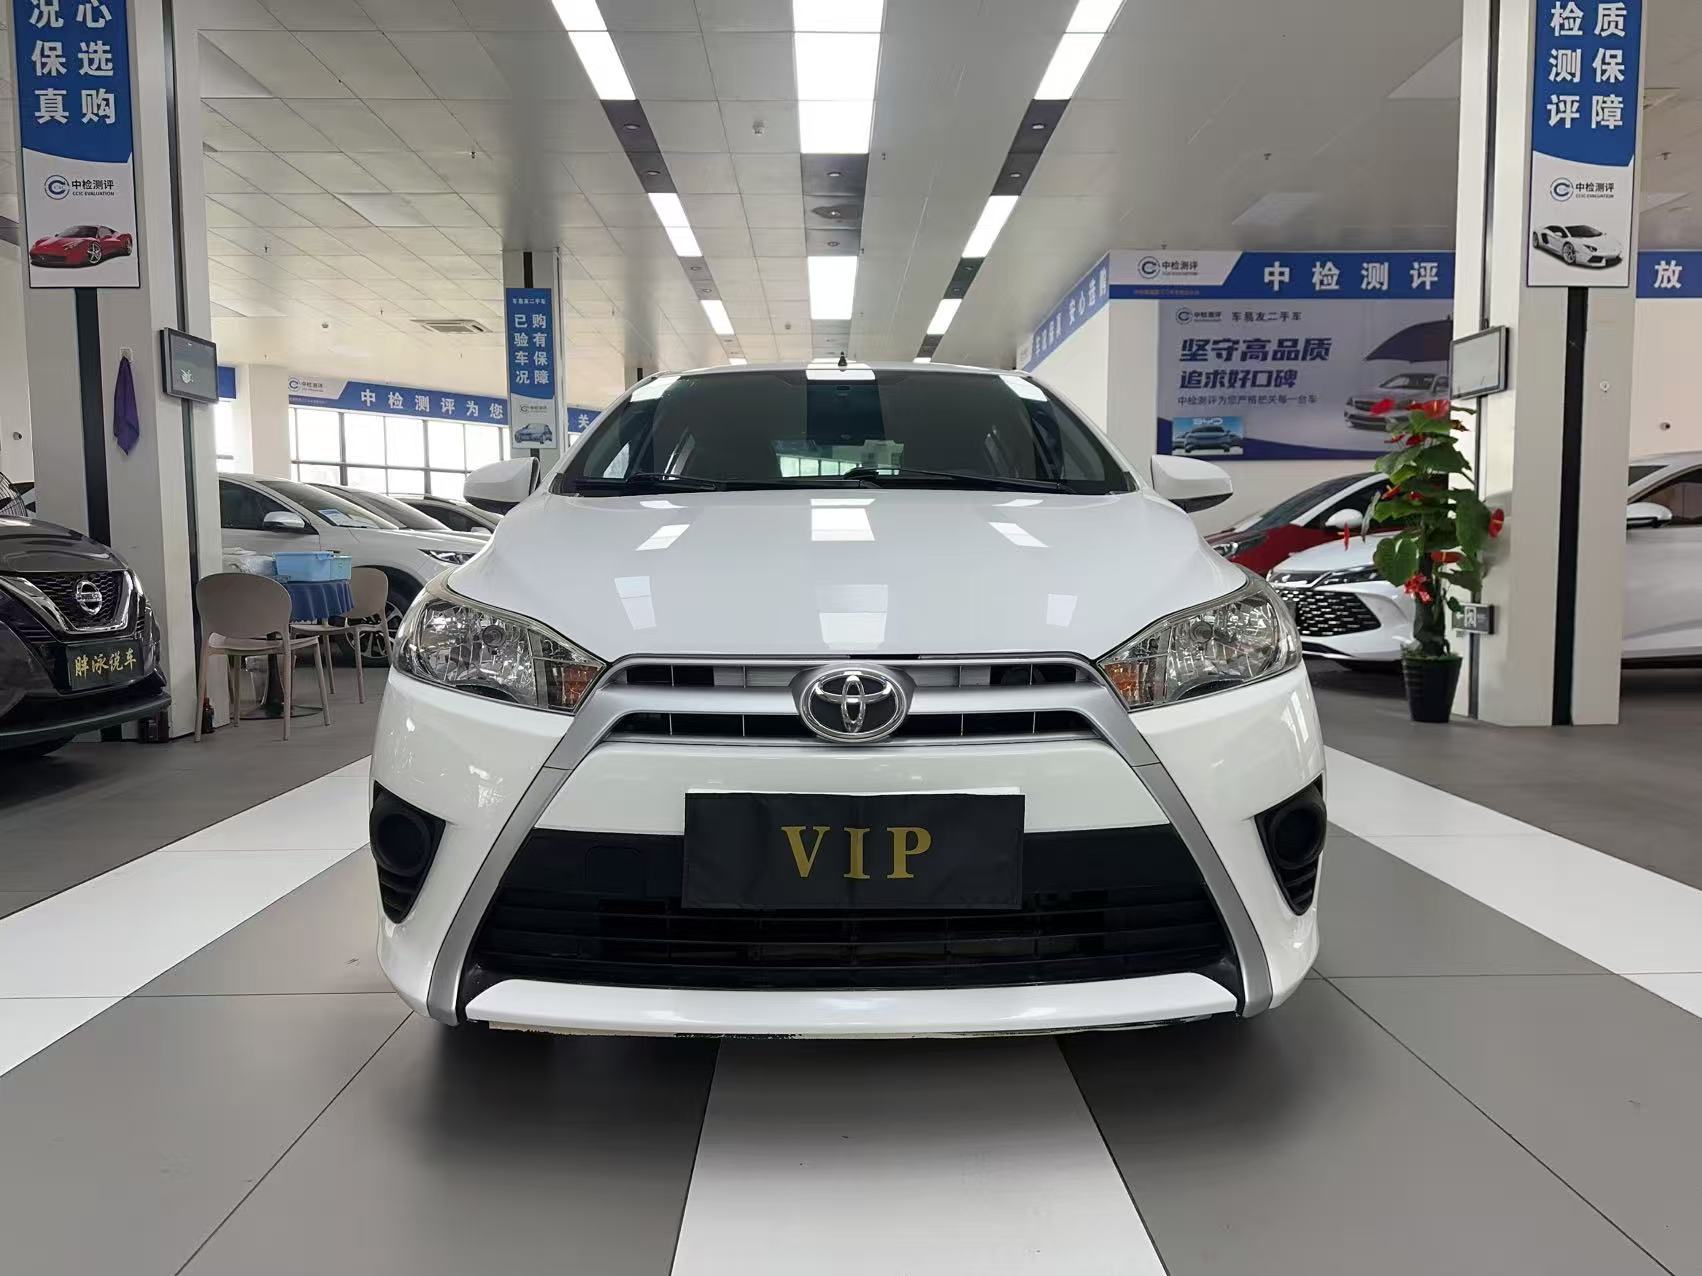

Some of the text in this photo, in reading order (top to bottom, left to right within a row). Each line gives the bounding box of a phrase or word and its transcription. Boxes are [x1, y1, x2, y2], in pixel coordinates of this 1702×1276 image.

[76, 0, 117, 125] 心选购
[1547, 1, 1584, 128] 检测评
[1591, 1, 1627, 129] 质保障
[71, 179, 115, 190] 中检测评
[1575, 182, 1615, 193] 中检测评
[1162, 261, 1199, 271] 中检测评
[1264, 260, 1683, 291] 中检测评 放
[513, 314, 530, 385] 已验车况
[532, 313, 549, 385] 购有保障
[1179, 337, 1332, 362] 坚守高品质
[1179, 368, 1298, 389] 追求好口碑
[360, 388, 504, 419] 中检测评为您
[781, 825, 932, 879] VIP
